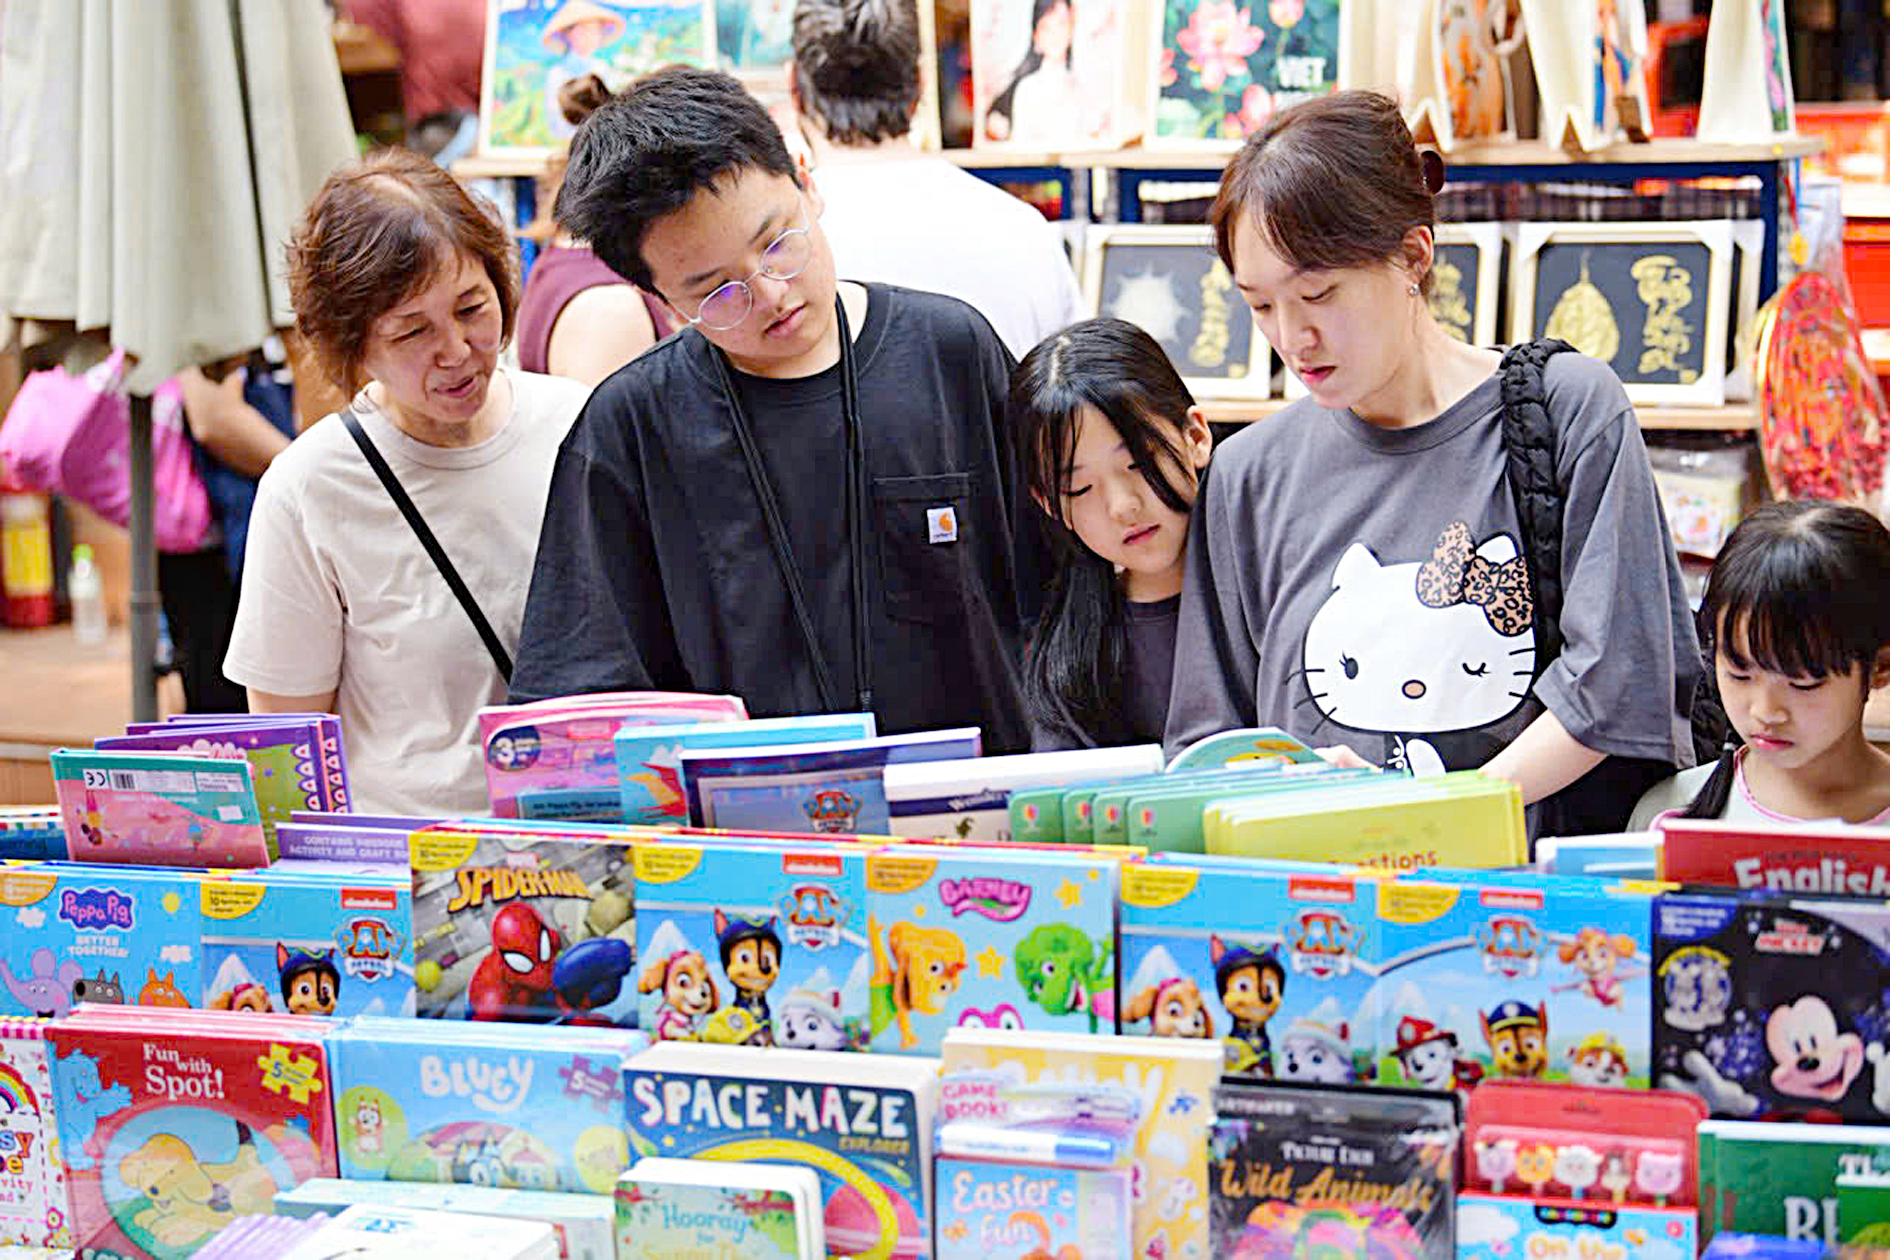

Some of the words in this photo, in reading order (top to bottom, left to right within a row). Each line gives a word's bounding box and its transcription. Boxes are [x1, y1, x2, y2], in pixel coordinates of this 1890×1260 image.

[65, 892, 106, 922] Peppa
[107, 895, 130, 923] Pig
[143, 1042, 180, 1062] Fun
[177, 1057, 212, 1075] with
[146, 1065, 226, 1101] Spot!
[633, 1076, 772, 1129] SPACE
[784, 1083, 909, 1138] MAZE
[954, 1170, 1059, 1214] Easter
[1219, 1158, 1294, 1198] Wild
[1296, 1166, 1437, 1212] Animals
[661, 1203, 748, 1243] Hooray
[980, 1213, 1032, 1252] fun
[1528, 1235, 1570, 1257] On
